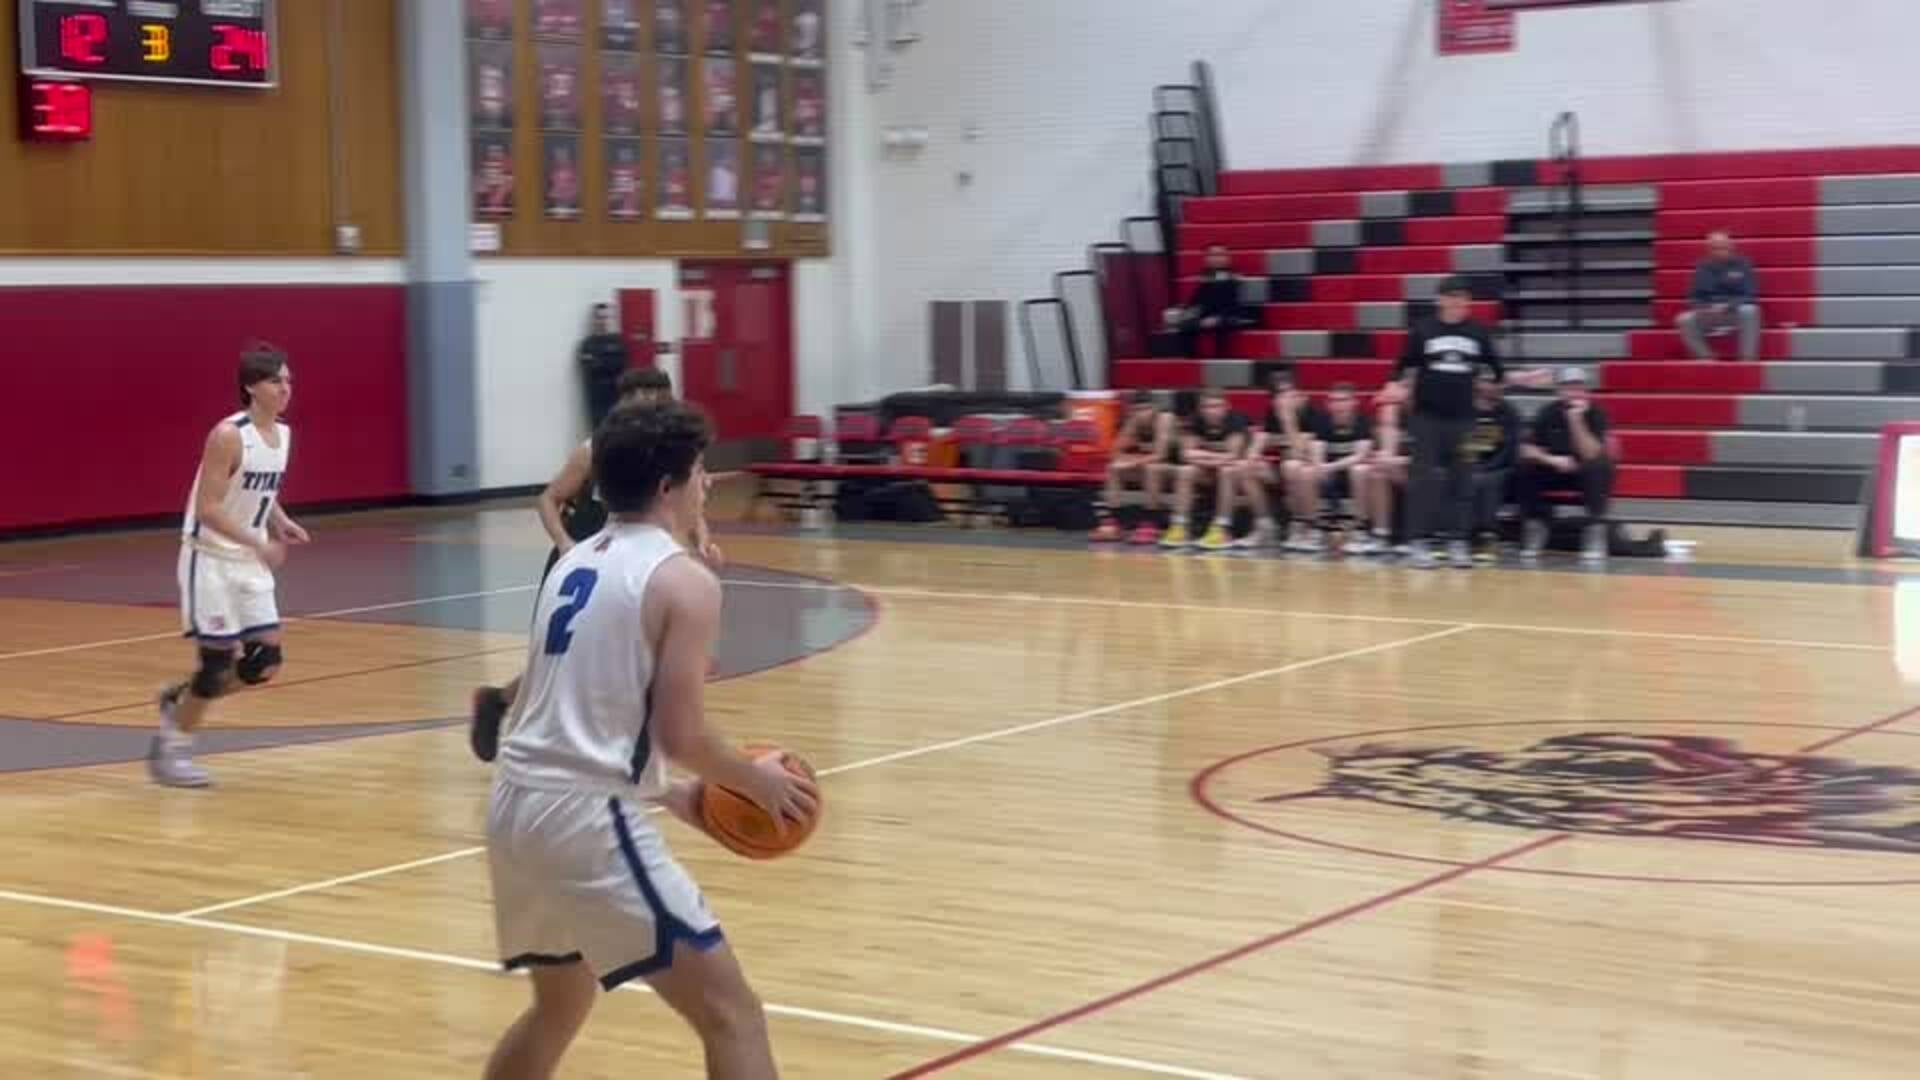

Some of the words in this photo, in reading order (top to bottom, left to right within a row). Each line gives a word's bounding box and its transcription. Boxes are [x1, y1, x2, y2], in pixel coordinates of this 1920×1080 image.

[141, 24, 170, 61] 3
[253, 497, 269, 527] 1
[545, 567, 598, 655] 2
